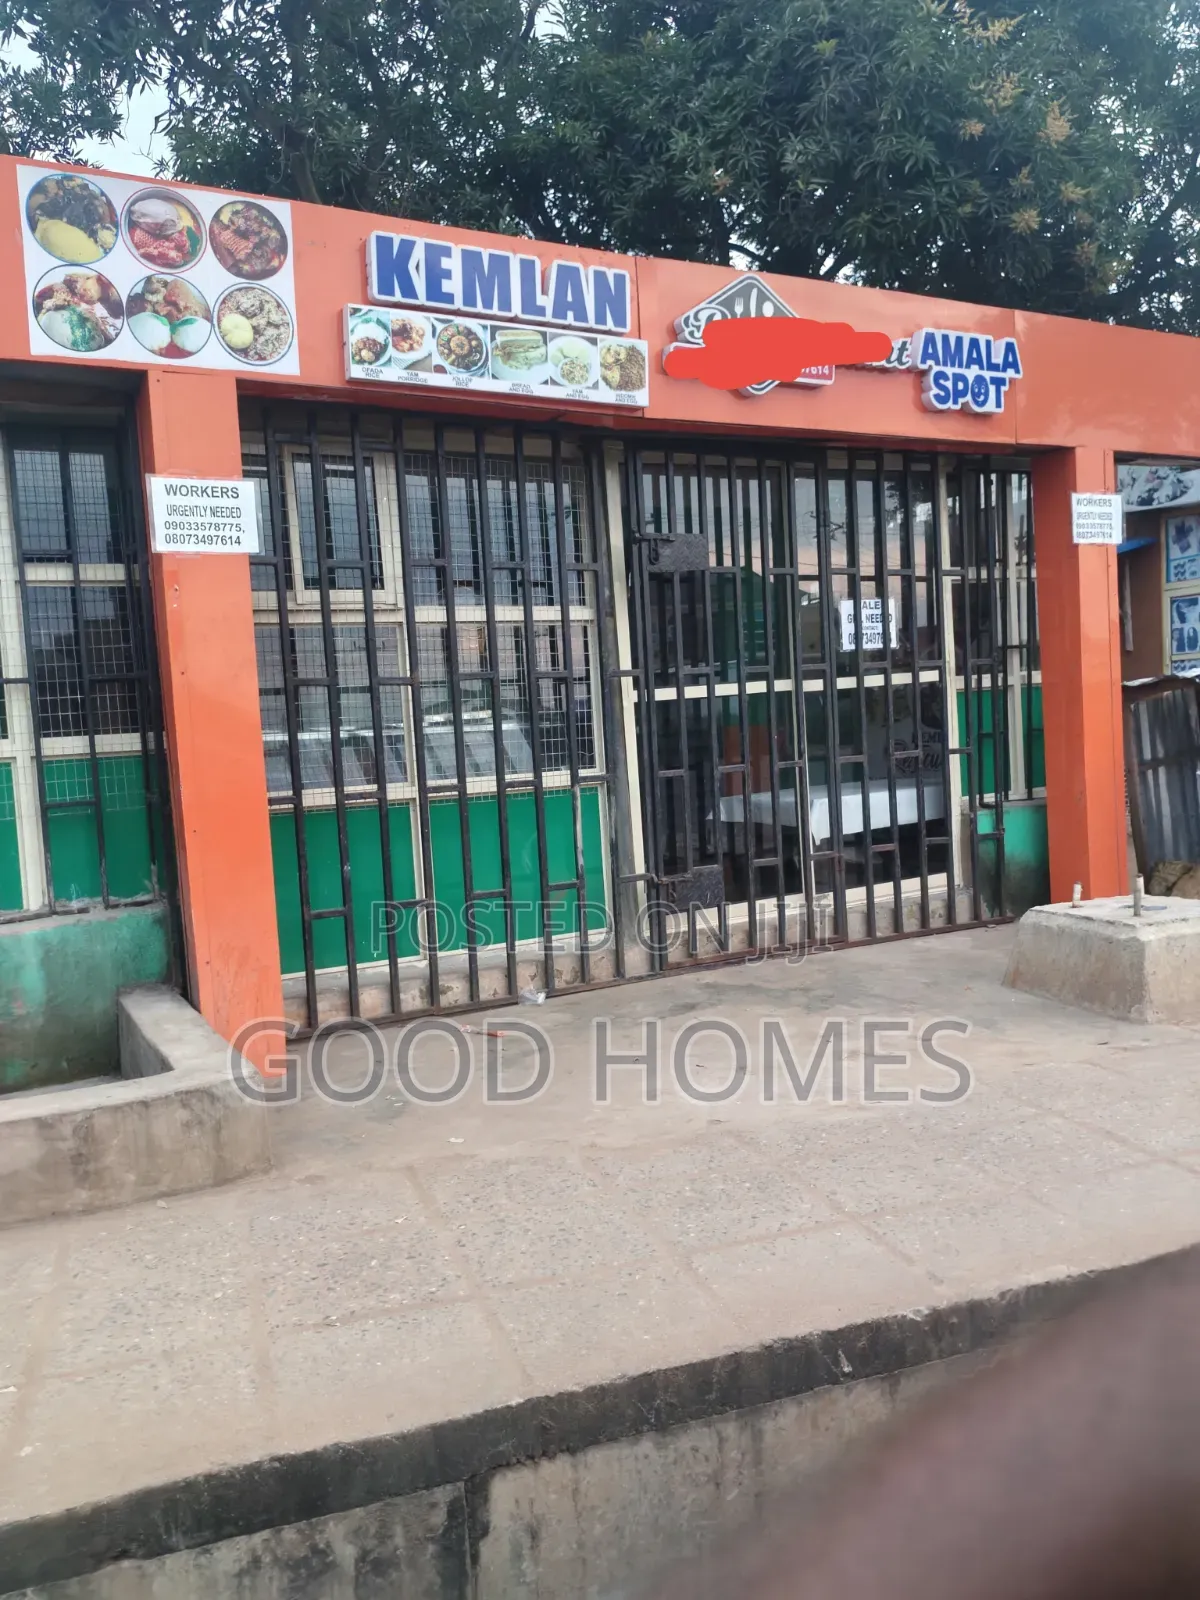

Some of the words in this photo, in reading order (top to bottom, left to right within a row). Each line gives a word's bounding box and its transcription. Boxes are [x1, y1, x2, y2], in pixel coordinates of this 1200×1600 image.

[373, 233, 629, 330] KEMLAN
[920, 331, 1020, 375] AMALA
[361, 366, 384, 375] OFADA
[932, 370, 1007, 408] SPOT
[164, 484, 240, 499] WORKERS
[1076, 498, 1113, 507] WORKERS
[166, 504, 208, 517] URGENTLY
[210, 505, 242, 519] NEEDED
[164, 521, 245, 534] 09033578775,
[164, 533, 241, 546] 08073497614
